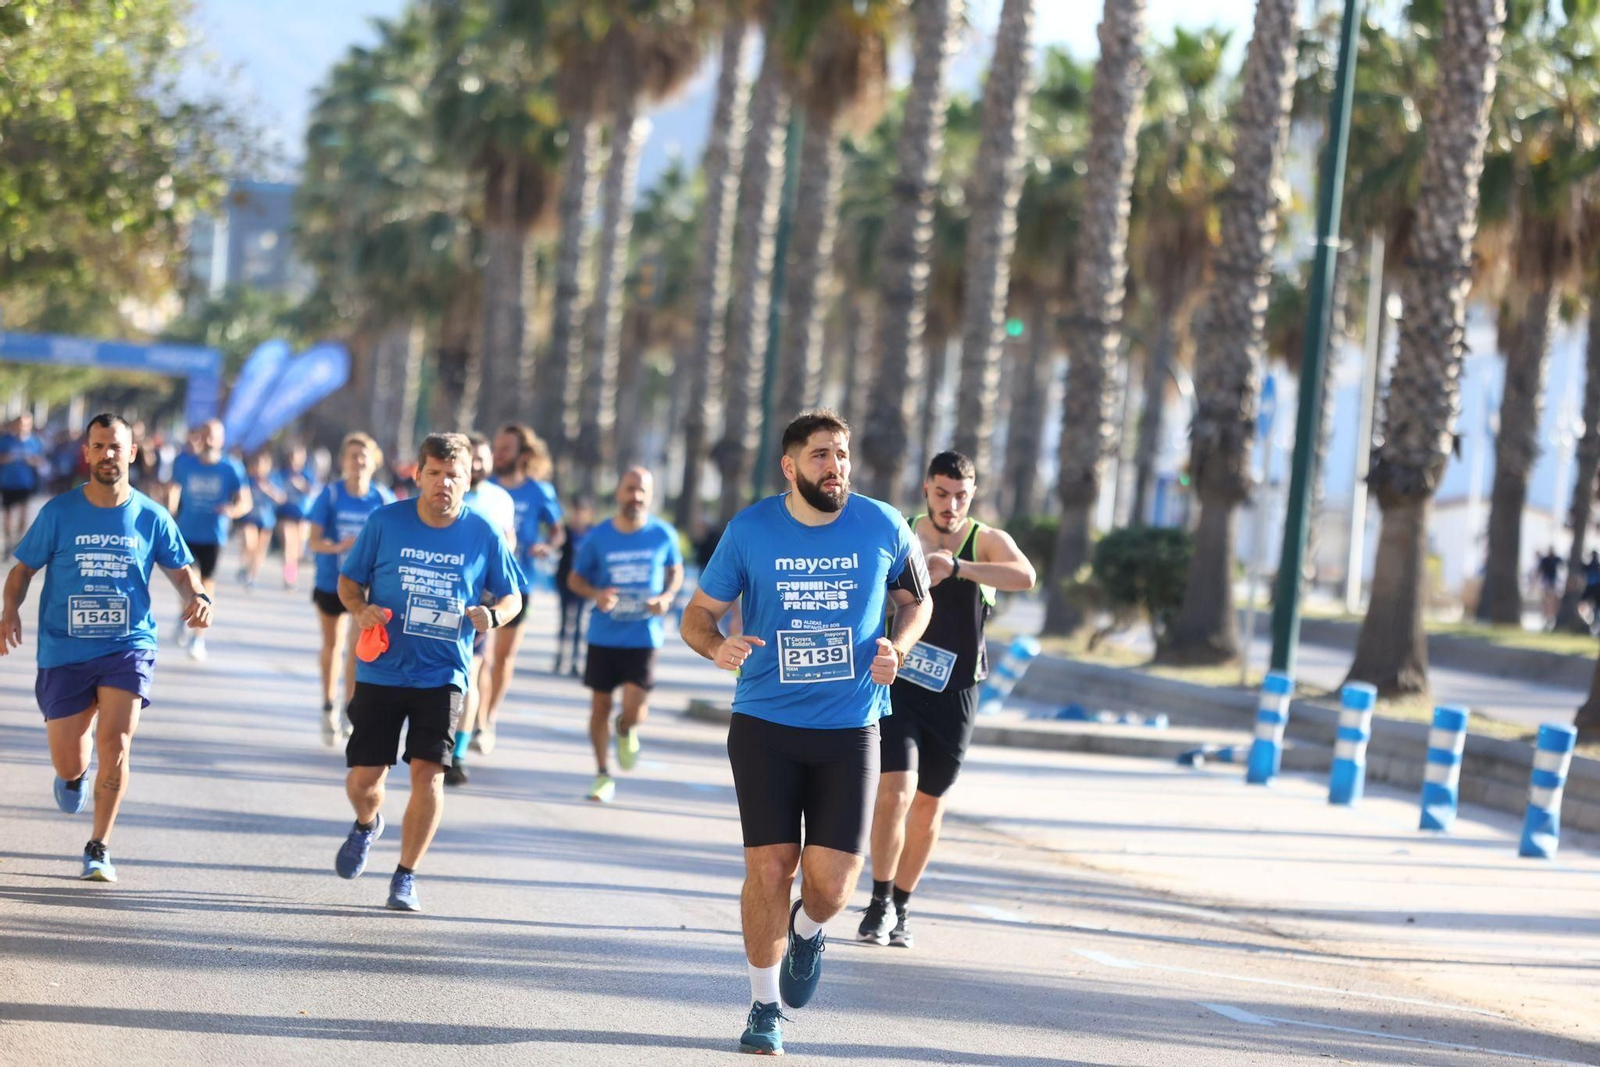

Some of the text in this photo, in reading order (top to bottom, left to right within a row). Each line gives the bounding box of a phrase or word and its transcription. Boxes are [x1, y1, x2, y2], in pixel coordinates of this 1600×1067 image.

[75, 534, 138, 548] mayoral
[400, 547, 465, 566] mayoral
[81, 562, 129, 570] MAKES
[775, 553, 859, 574] mayoral
[80, 569, 128, 578] FRIENDS
[403, 575, 453, 588] MAKES
[776, 580, 854, 592] RUNNING
[402, 583, 453, 597] FRIENDS
[784, 591, 847, 601] MAKES
[783, 601, 849, 610] FRIENDS
[77, 611, 121, 623] 1543
[432, 611, 441, 623] 7
[789, 648, 843, 665] 2139
[904, 654, 944, 677] 2138
